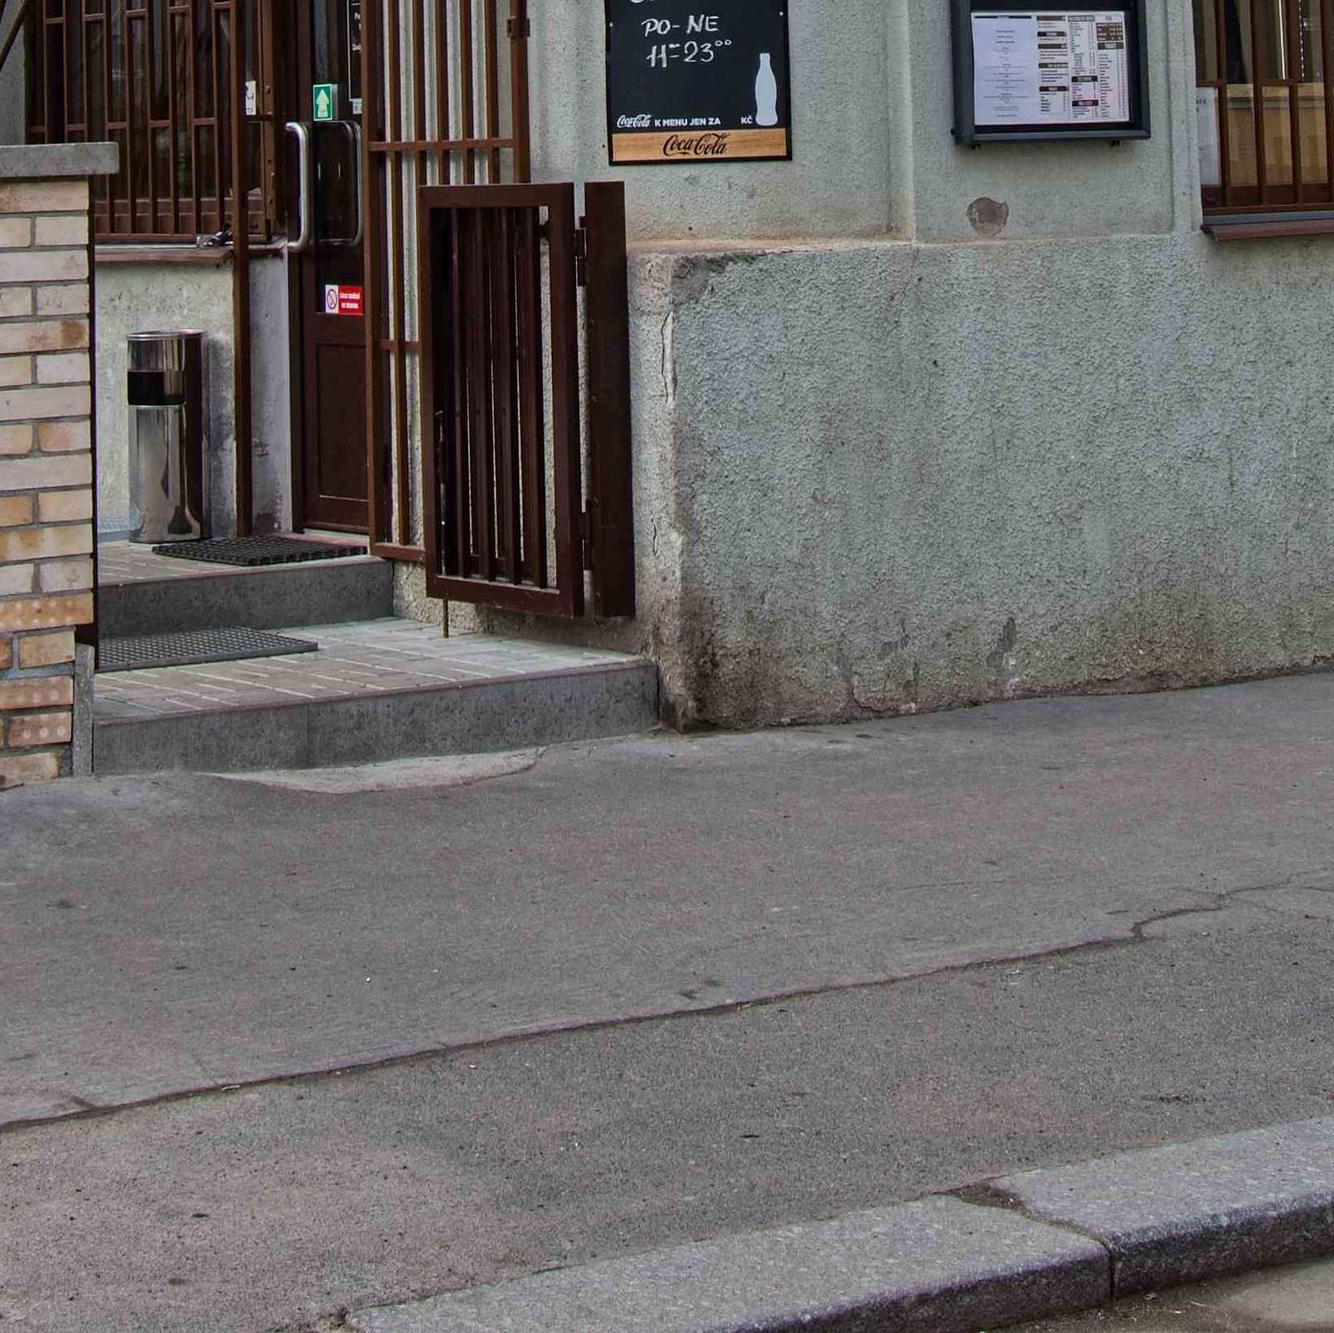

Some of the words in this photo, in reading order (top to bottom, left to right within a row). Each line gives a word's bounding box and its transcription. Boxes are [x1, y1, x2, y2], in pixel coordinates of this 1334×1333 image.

[654, 118, 662, 127] K
[662, 117, 688, 127] MENU
[689, 117, 707, 127] JEN
[708, 116, 722, 126] ZA
